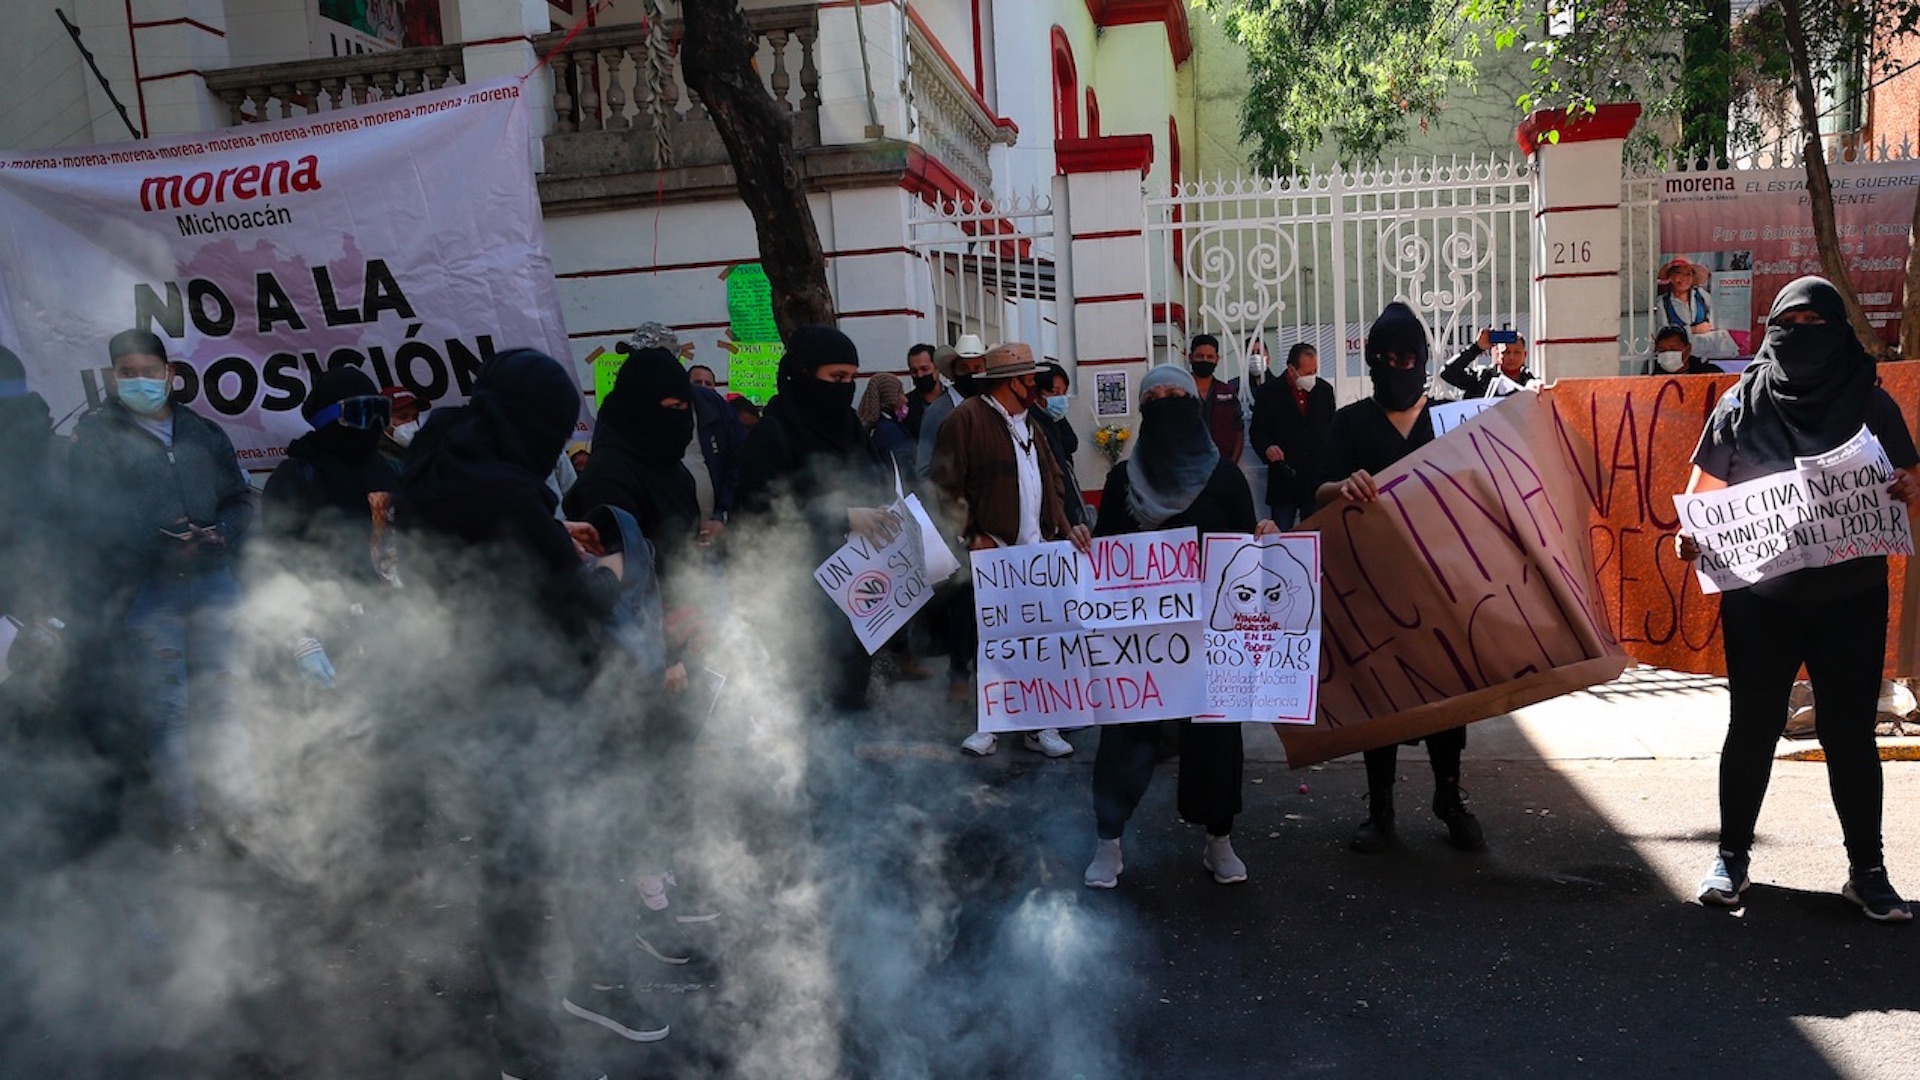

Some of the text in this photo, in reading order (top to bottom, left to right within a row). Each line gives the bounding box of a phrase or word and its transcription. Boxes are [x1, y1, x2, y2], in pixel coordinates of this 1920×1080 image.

[140, 154, 322, 212] morena
[1666, 175, 1919, 193] morena EL ESTA DE GUERRE
[176, 206, 292, 238] Michoacán
[1762, 225, 1816, 240] Gobiern
[1553, 240, 1591, 264] 216
[133, 258, 416, 339] NO A LA
[80, 323, 497, 418] IPOSIIÓN
[1687, 482, 1803, 531] COLECTIVA
[1700, 539, 1781, 574] AGRESOR
[1841, 505, 1903, 538] PODER
[820, 556, 853, 591] UN
[976, 540, 1201, 589] NINGÚN VIOLADOR
[981, 593, 1195, 627] EN EL PODER EN
[984, 628, 1191, 670] ESTE MÉXICO
[1244, 632, 1275, 641] EN EL
[984, 671, 1164, 716] FEMINICIDA
